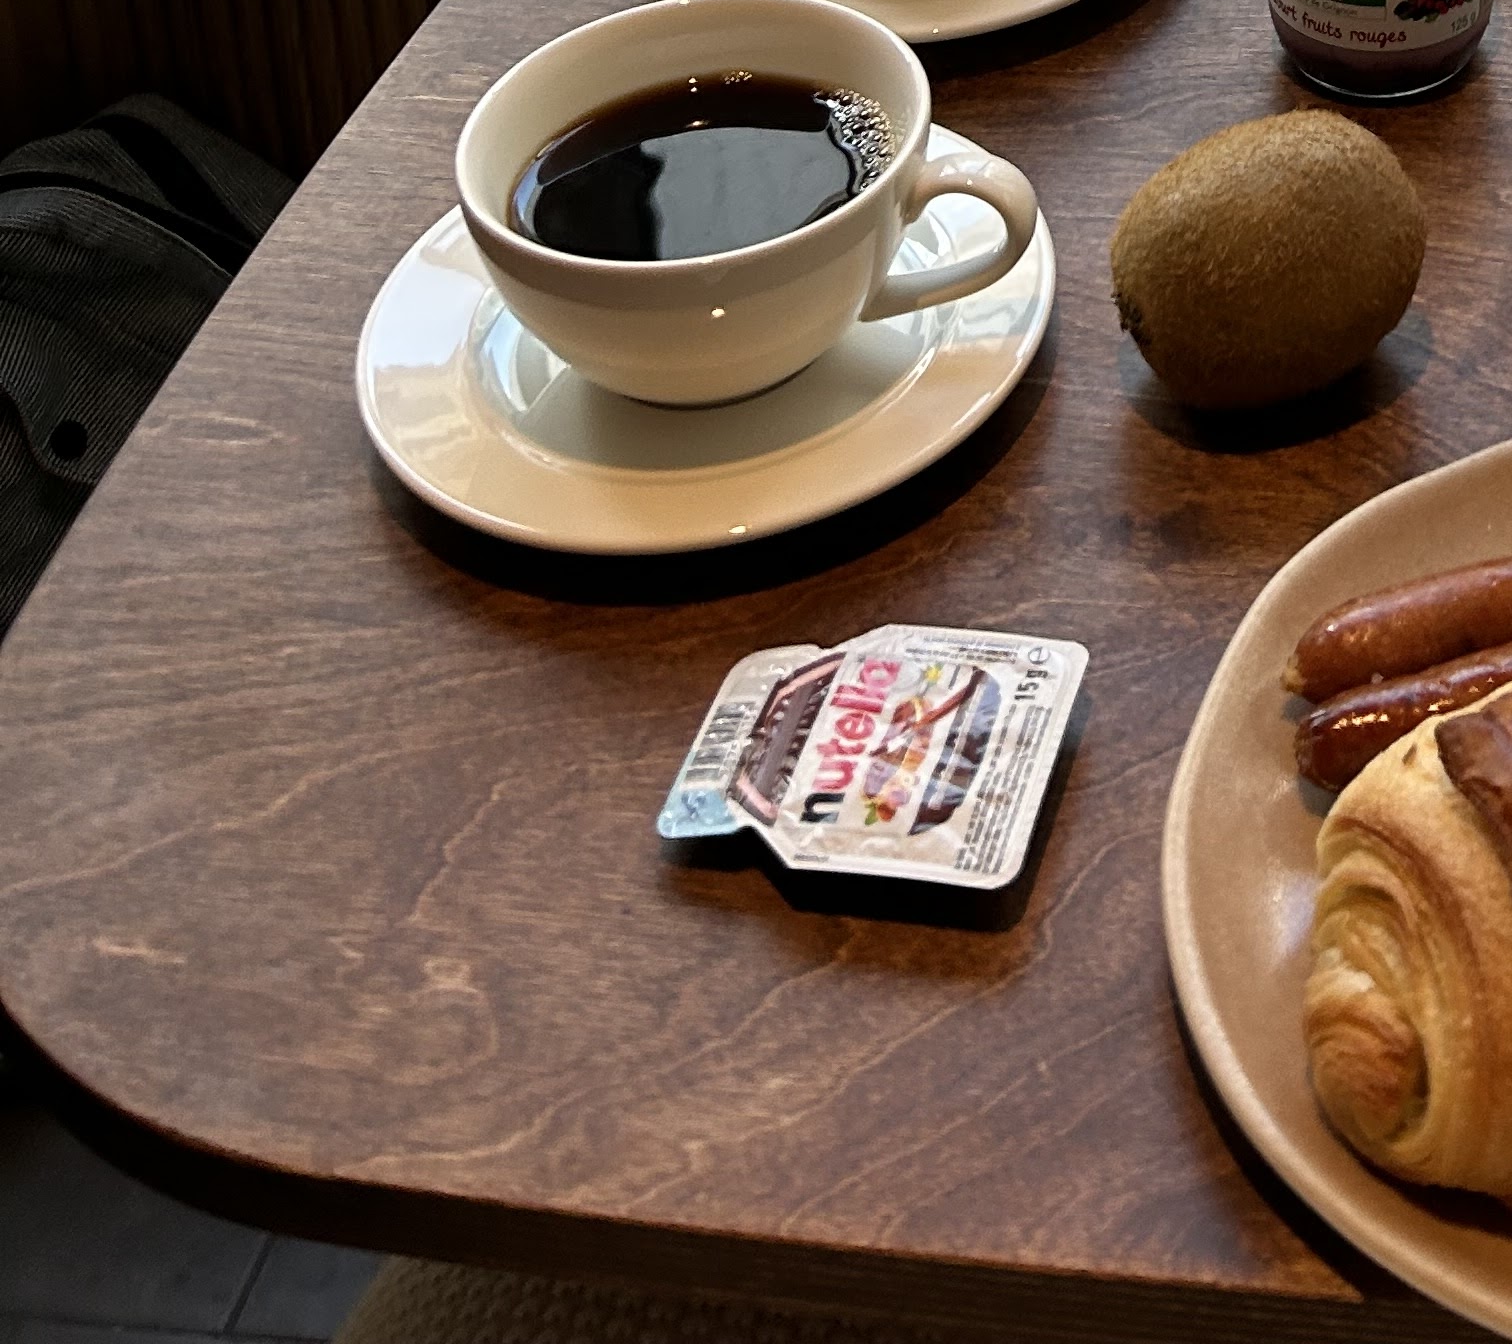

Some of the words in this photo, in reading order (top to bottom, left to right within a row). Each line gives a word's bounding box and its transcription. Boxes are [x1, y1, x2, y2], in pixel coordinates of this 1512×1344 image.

[1301, 11, 1343, 40] fruits
[1349, 29, 1407, 48] rouges
[800, 658, 902, 824] nutella
